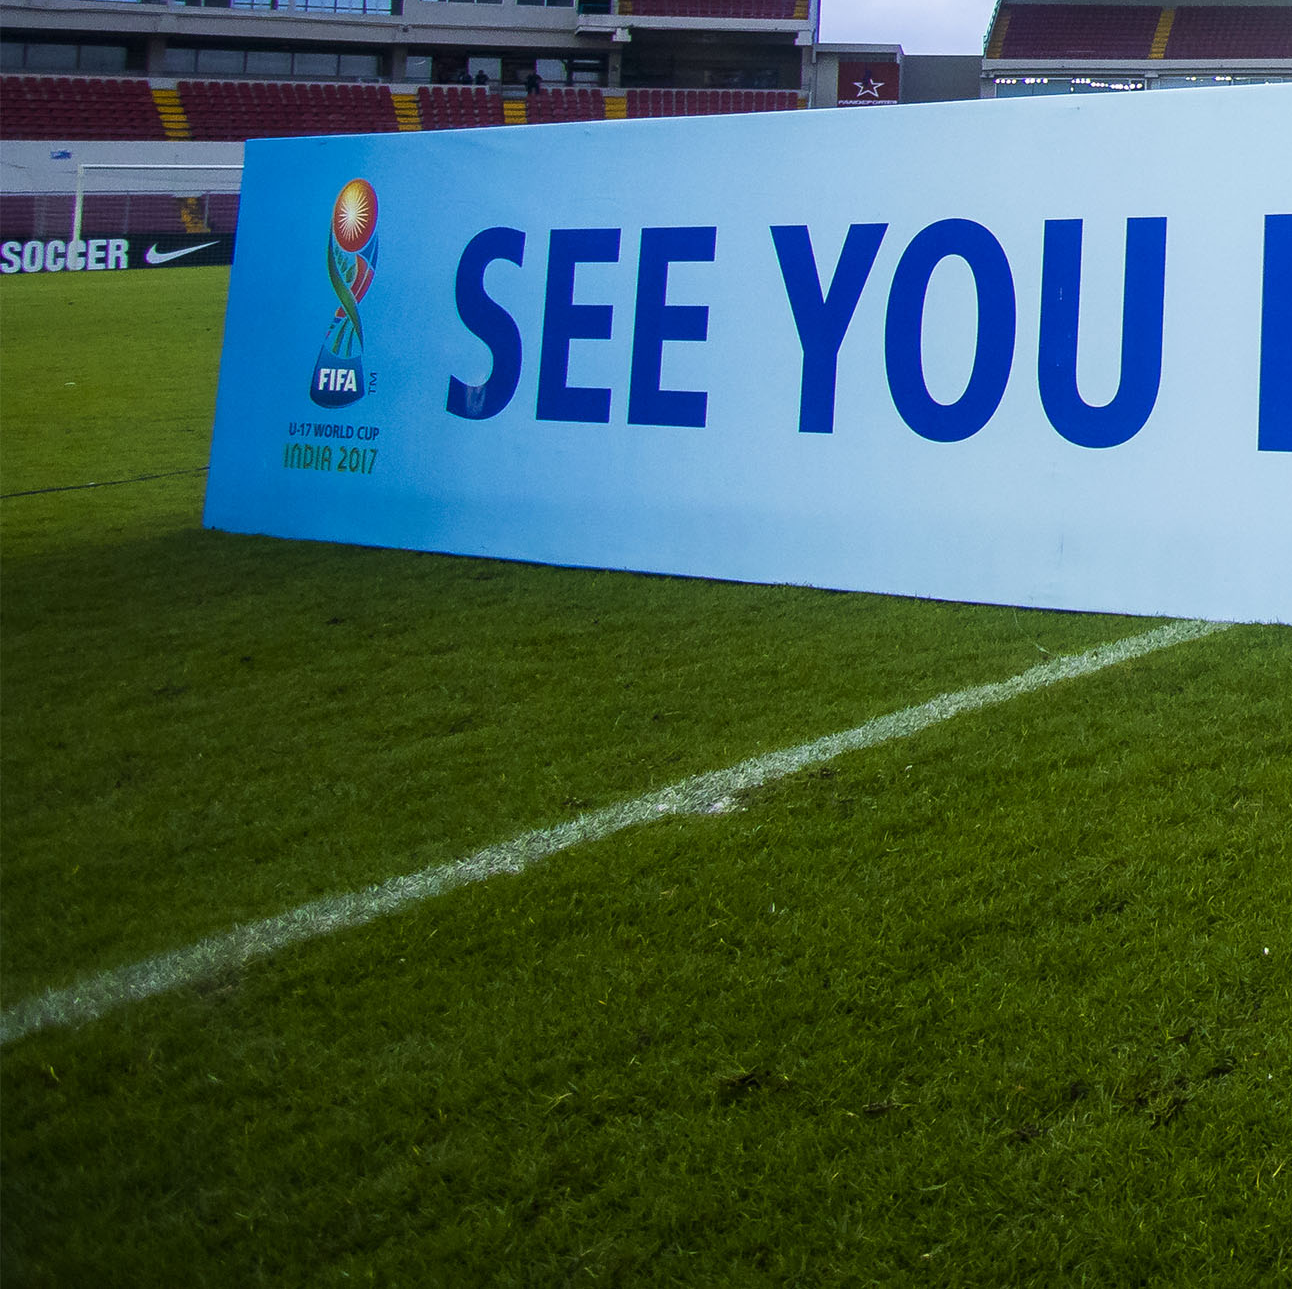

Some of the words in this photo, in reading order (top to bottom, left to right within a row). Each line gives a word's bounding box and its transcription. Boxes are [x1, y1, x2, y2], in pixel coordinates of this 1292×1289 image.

[1, 239, 129, 273] SOCCER
[447, 226, 717, 429] SEE
[770, 217, 1167, 449] YOU
[318, 368, 357, 392] FIFA
[289, 422, 312, 437] U-17
[314, 423, 354, 439] WORLD
[357, 426, 380, 441] CUP
[284, 443, 332, 471] INDIA
[337, 446, 379, 474] 2017
